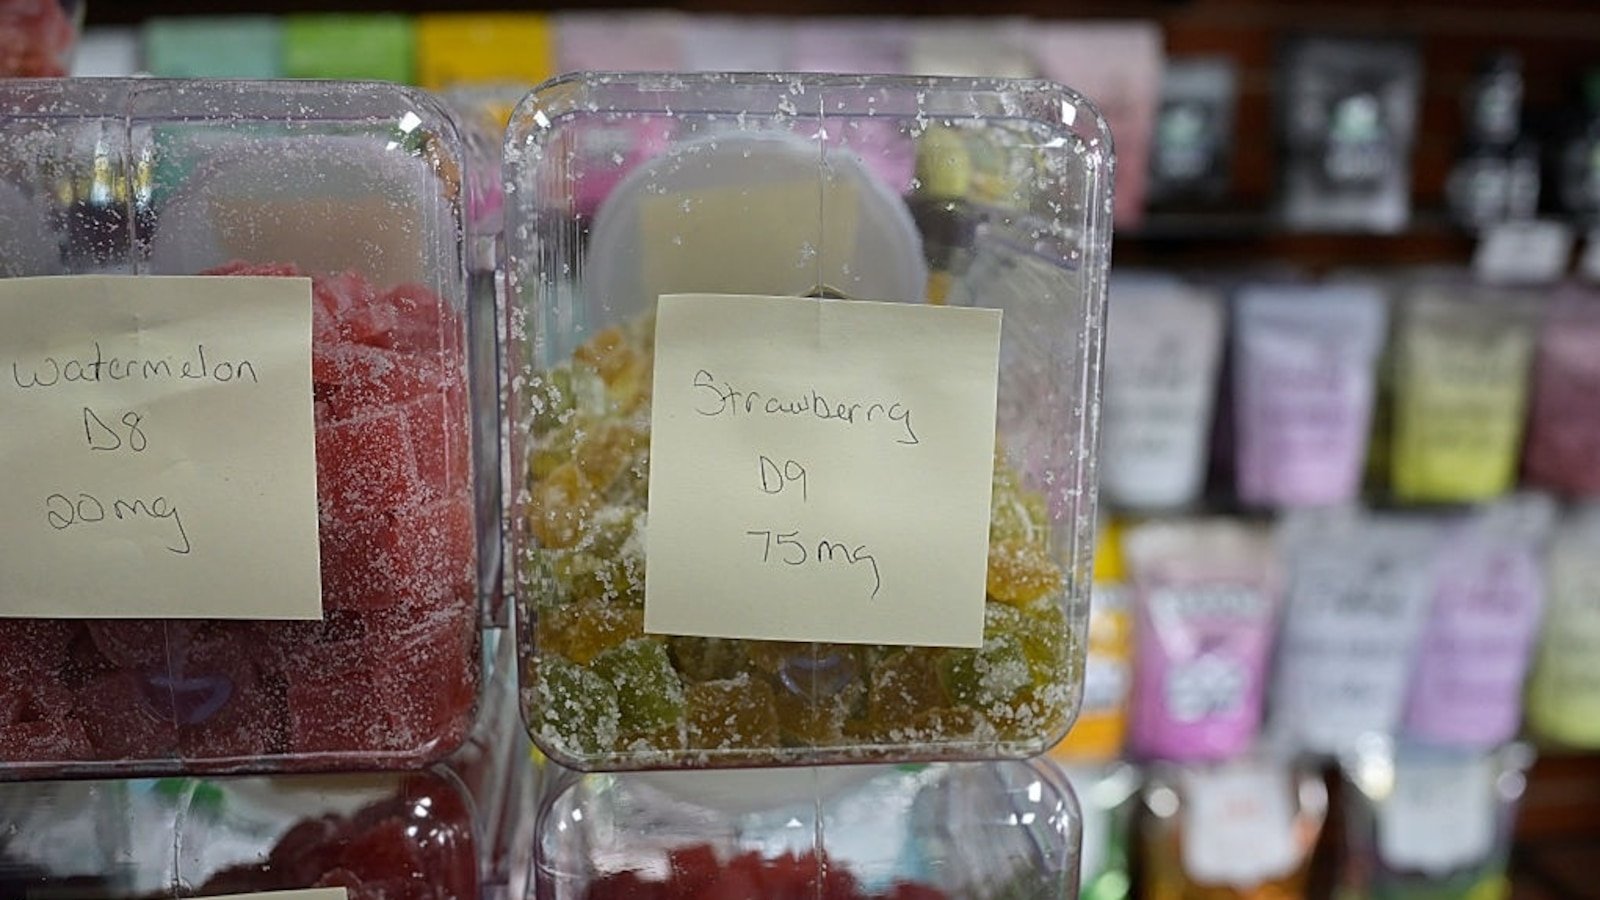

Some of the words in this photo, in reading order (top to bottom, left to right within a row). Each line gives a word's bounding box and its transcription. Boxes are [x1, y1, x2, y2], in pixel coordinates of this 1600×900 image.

[84, 407, 147, 452] D8
[693, 369, 919, 444] Strawberry
[759, 455, 807, 503] D9
